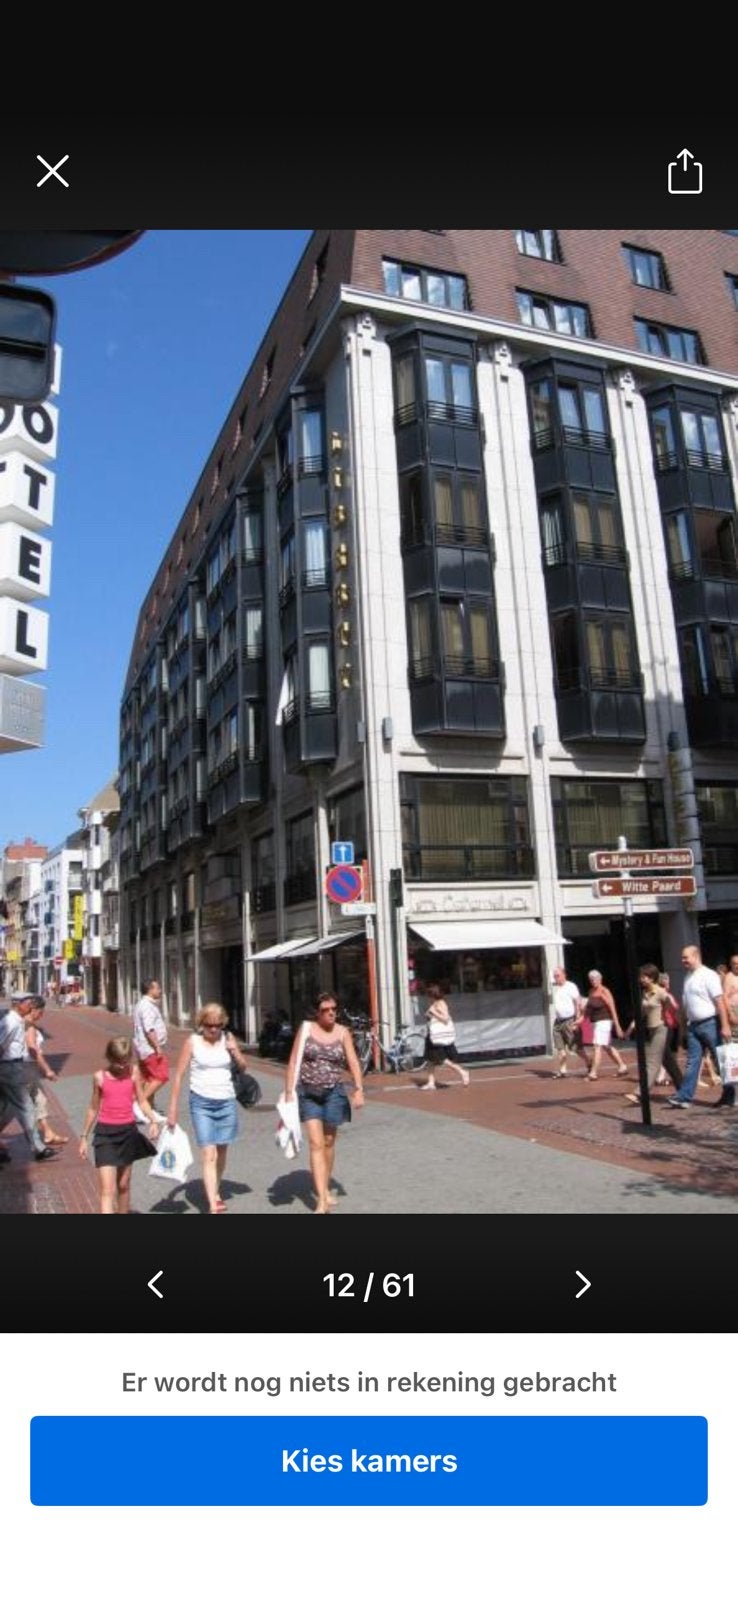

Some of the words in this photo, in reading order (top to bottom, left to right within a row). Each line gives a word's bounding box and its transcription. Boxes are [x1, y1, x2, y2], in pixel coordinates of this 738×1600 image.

[16, 404, 54, 659] OTEL
[611, 854, 643, 867] Mystery
[644, 854, 650, 865] &
[652, 854, 667, 864] Fun
[668, 853, 690, 863] House
[622, 881, 648, 893] Witte
[652, 881, 682, 892] Paard
